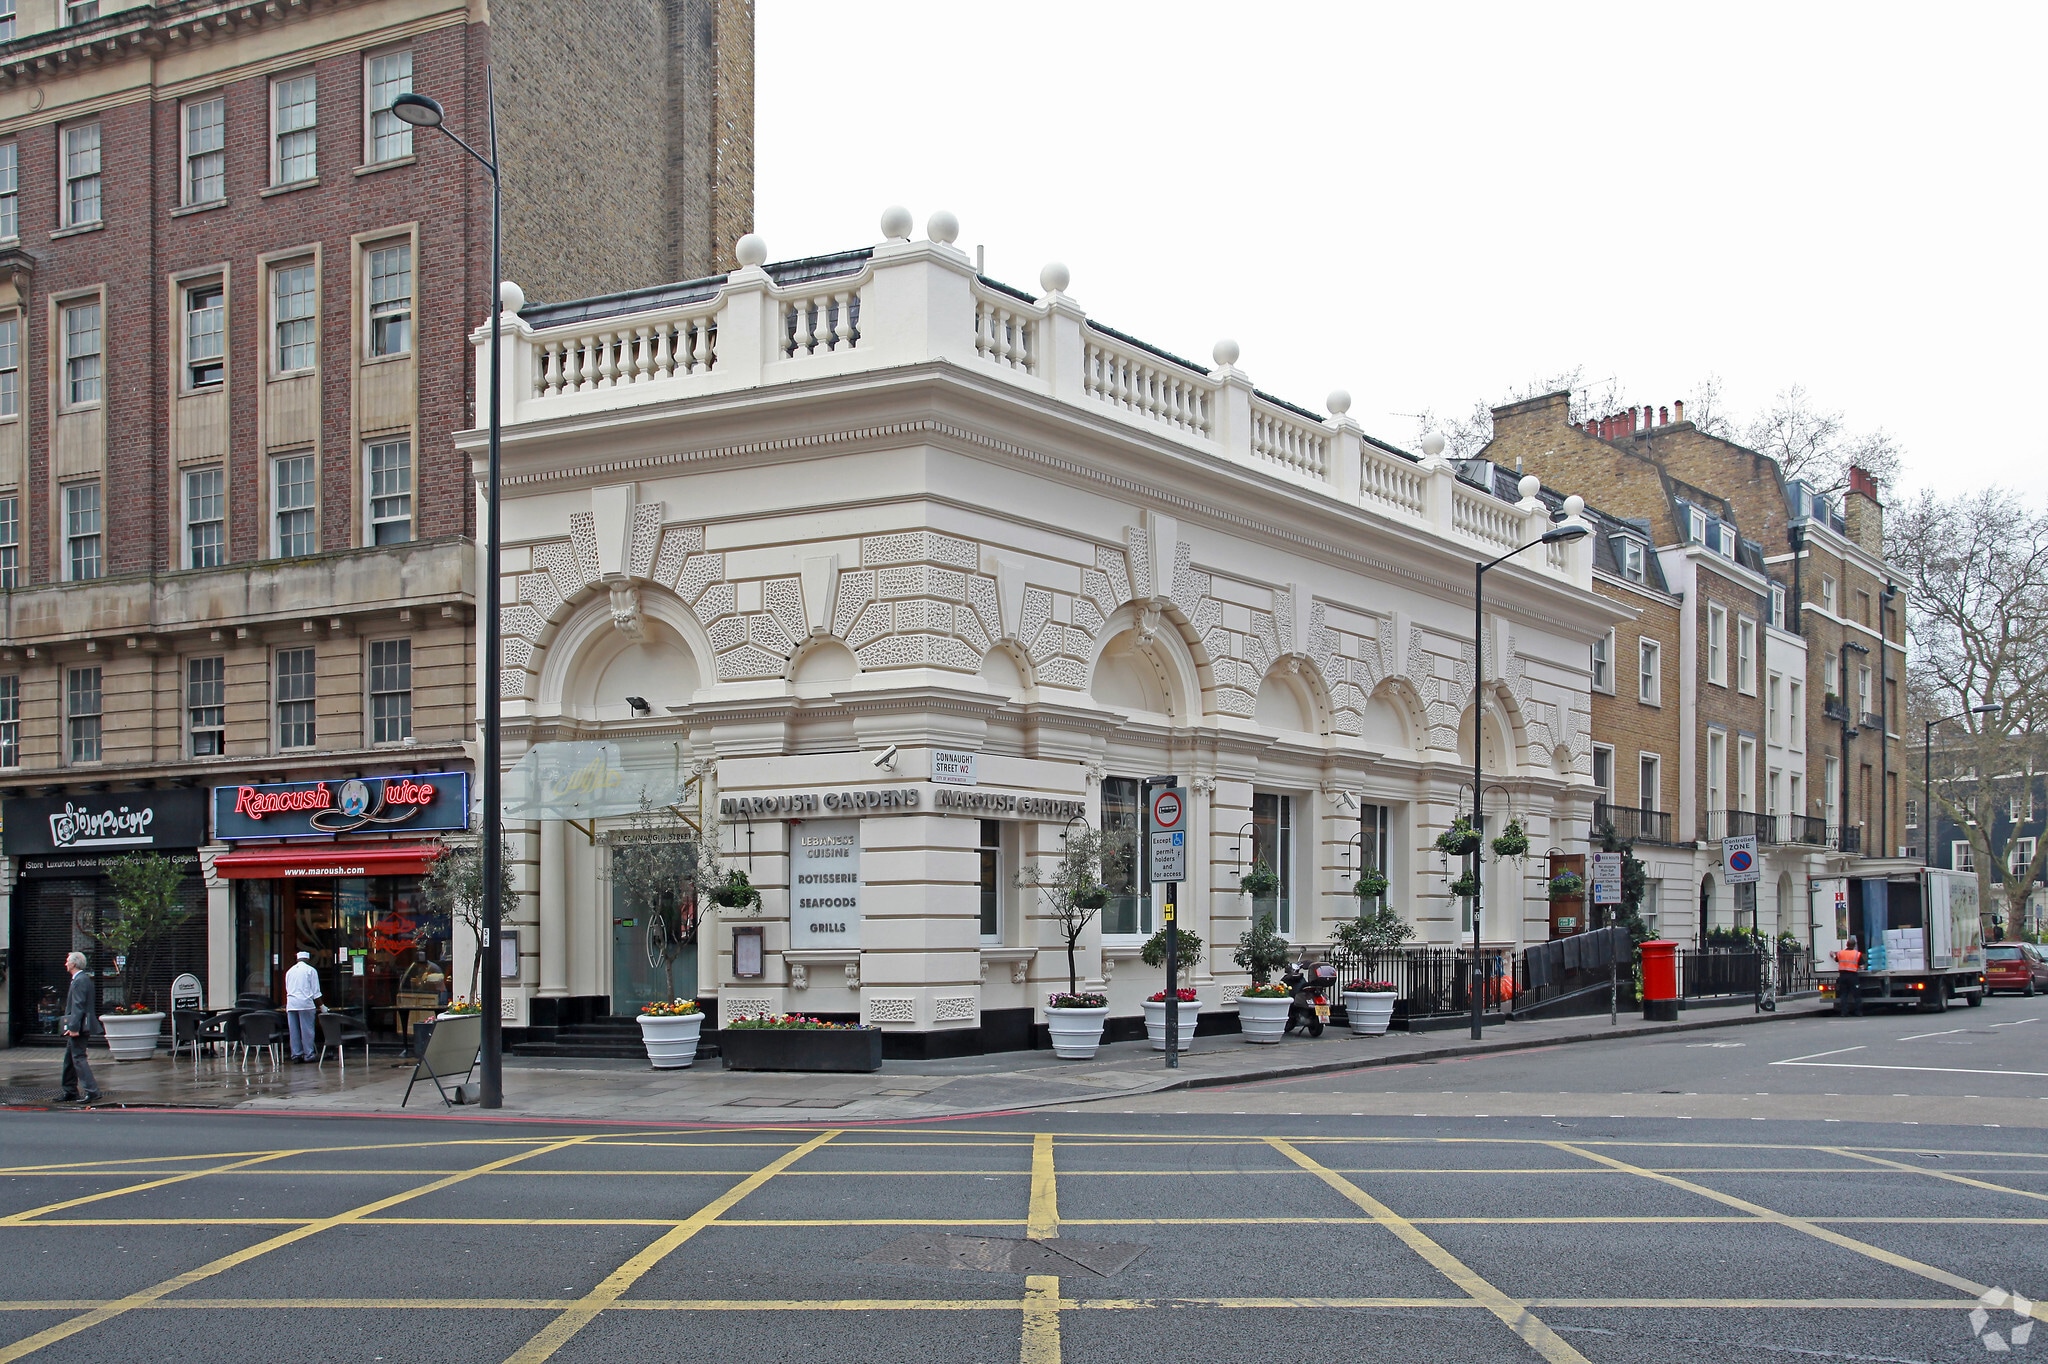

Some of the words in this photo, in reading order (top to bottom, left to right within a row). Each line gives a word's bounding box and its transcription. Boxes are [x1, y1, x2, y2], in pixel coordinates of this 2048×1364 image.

[936, 752, 973, 764] CONNAUGHT
[936, 763, 959, 773] STREET
[960, 765, 969, 774] W2
[234, 781, 330, 820] Ranoush
[720, 793, 819, 815] MAROUSH
[823, 789, 919, 810] GARDENS
[935, 789, 1017, 812] MAROUSH
[1017, 796, 1086, 817] GARDENS
[800, 835, 854, 846] LEBANESE
[1724, 836, 1755, 845] Controlled
[806, 847, 850, 858] CUISINE
[1729, 843, 1751, 851] ZONE
[25, 861, 43, 869] iStore
[46, 859, 76, 869] Luxurious
[77, 859, 97, 867] Mobile
[284, 865, 365, 876] www.maroush.com
[798, 873, 857, 884] ROTISSERIE
[799, 897, 856, 908] SEAFOODS
[1164, 906, 1173, 919] H
[809, 922, 846, 933] GRILLS
